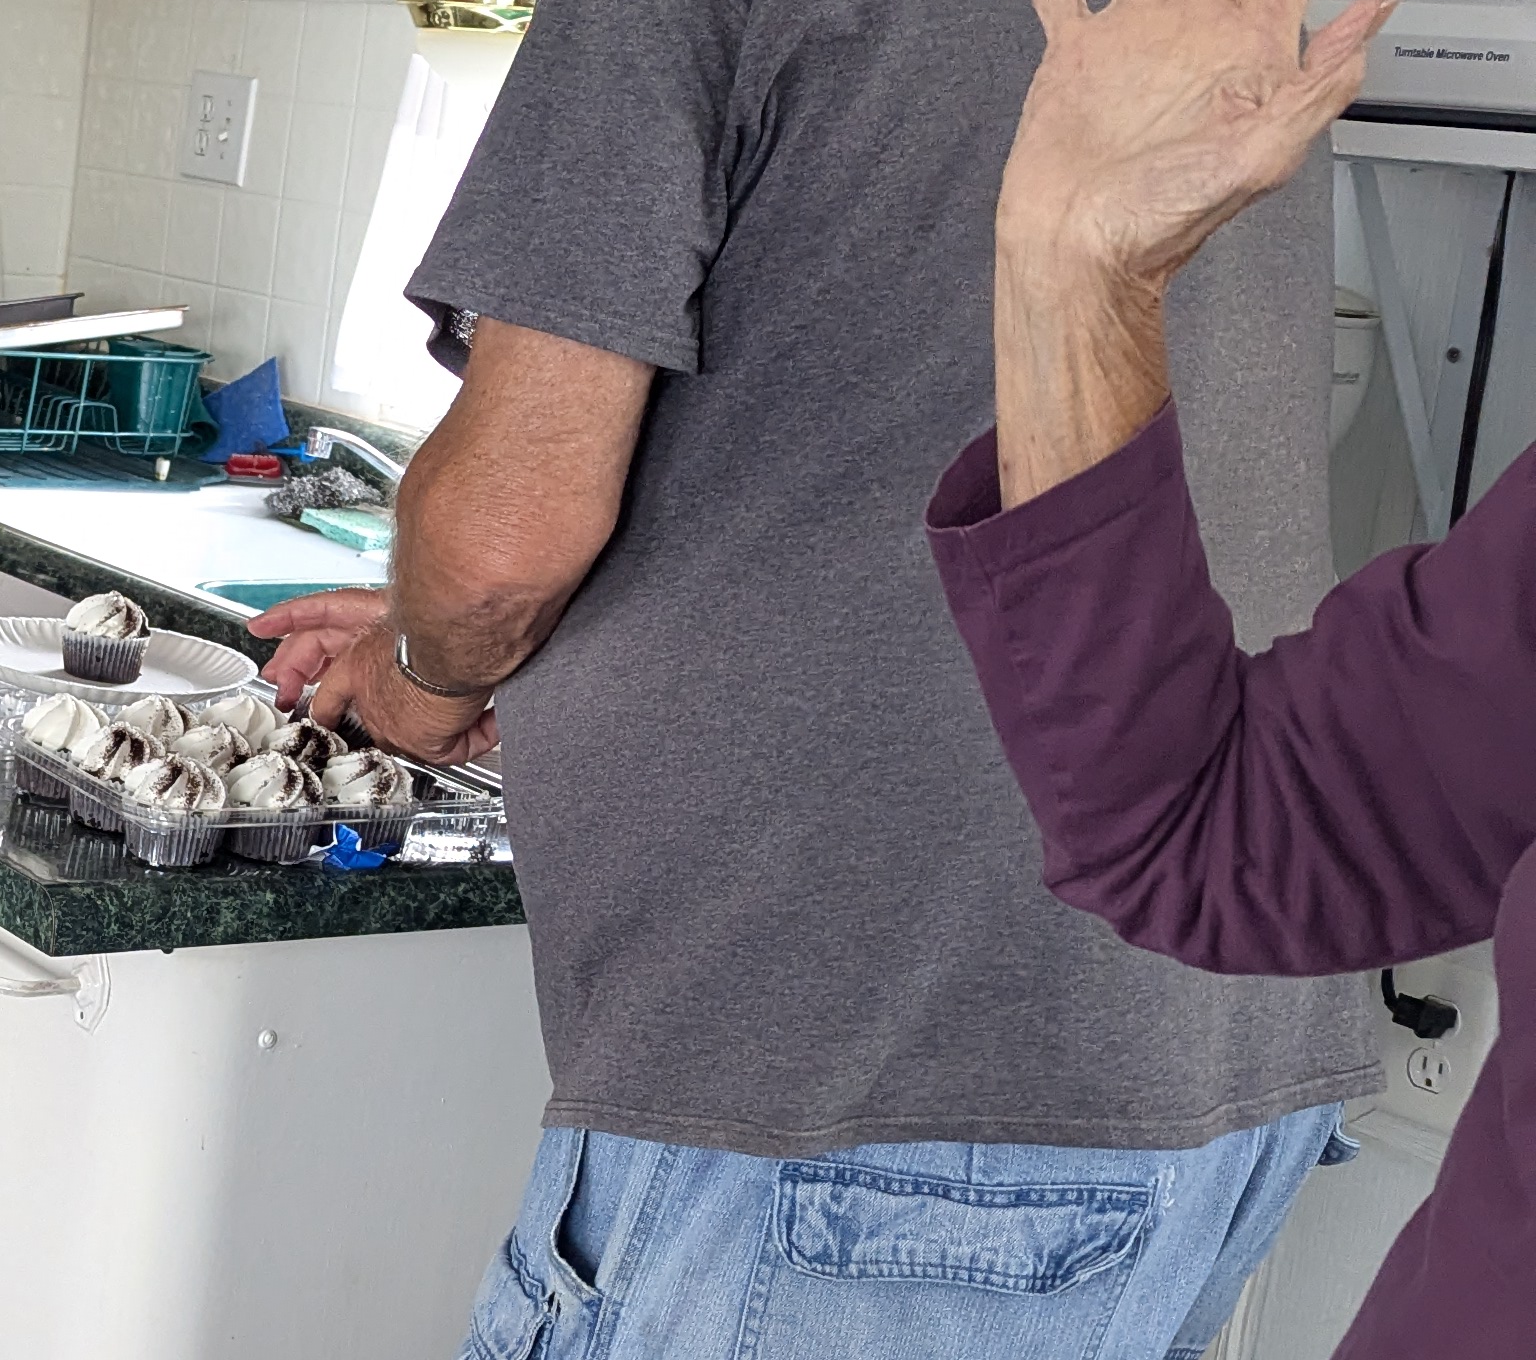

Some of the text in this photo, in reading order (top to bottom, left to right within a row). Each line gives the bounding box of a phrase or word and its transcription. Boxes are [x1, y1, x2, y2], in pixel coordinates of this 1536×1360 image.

[1394, 46, 1510, 62] Turntable Microwave Oven
